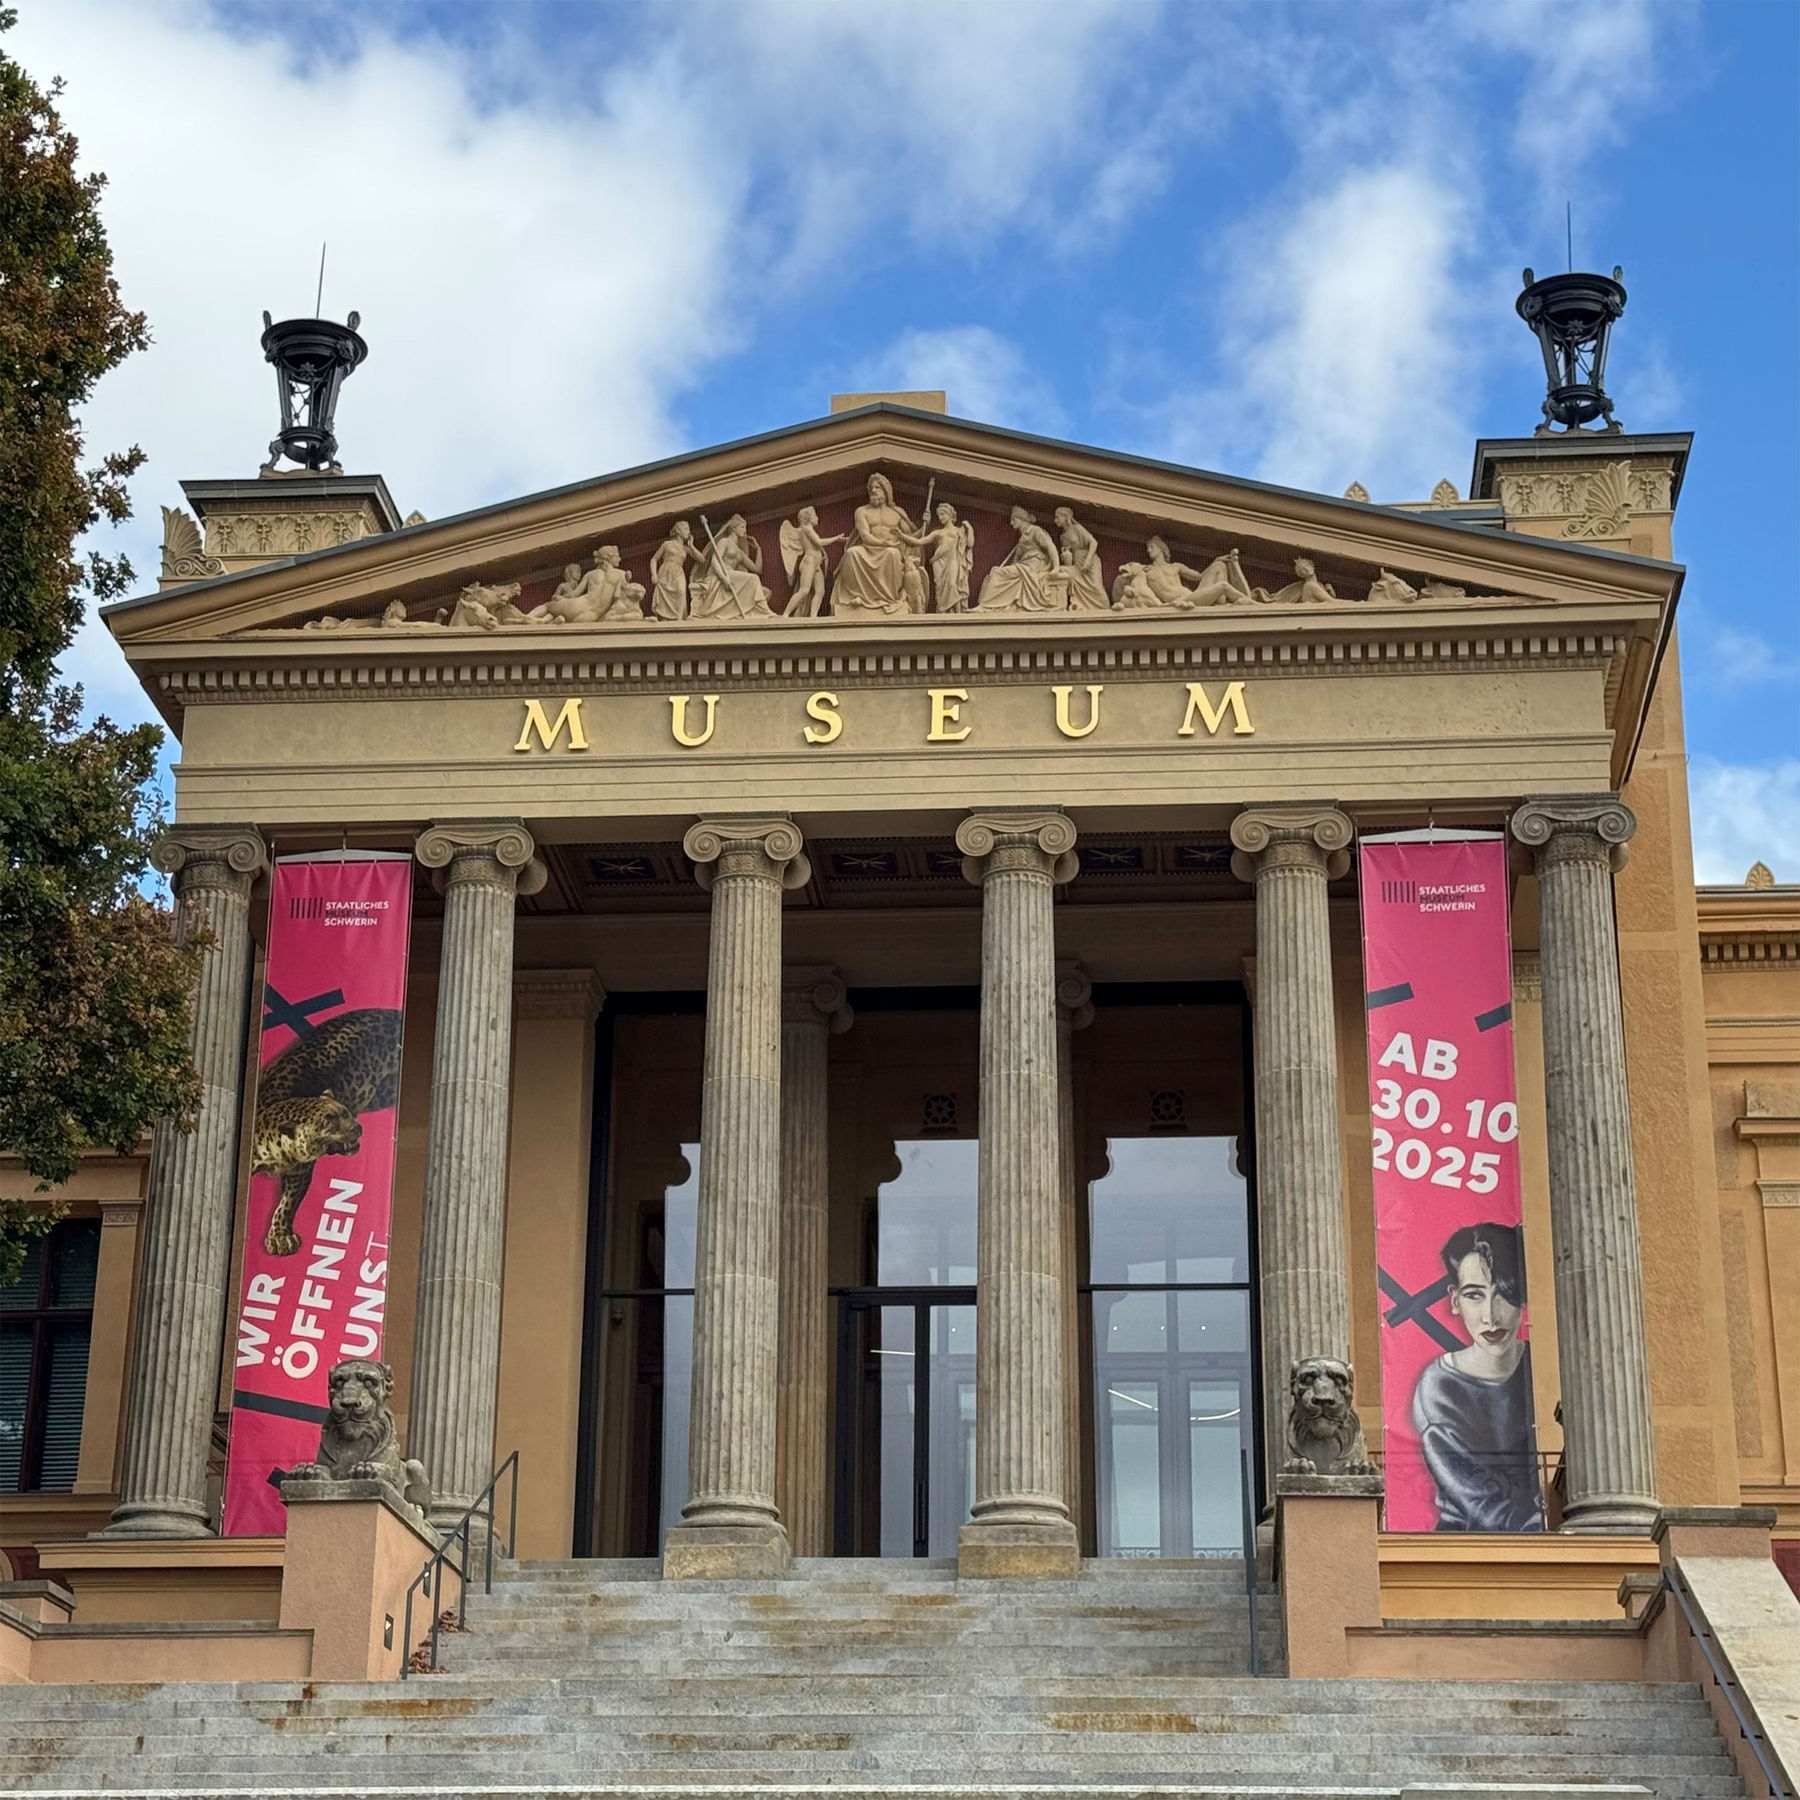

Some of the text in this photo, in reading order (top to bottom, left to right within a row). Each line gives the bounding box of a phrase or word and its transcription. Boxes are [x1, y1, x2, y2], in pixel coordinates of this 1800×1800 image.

[514, 681, 1255, 751] MUSEUM
[325, 901, 389, 910] STAATLICHES
[1419, 884, 1486, 895] STAATLICHES
[1420, 894, 1465, 903] MUSEUM
[1420, 902, 1476, 912] SCHWERIN
[324, 917, 378, 927] SCHWERIN
[1377, 1031, 1459, 1080] AB
[1373, 1127, 1501, 1194] 2025
[271, 1178, 364, 1379] ÖFFNEN
[336, 1231, 388, 1363] UNST
[236, 1273, 286, 1368] WIR
